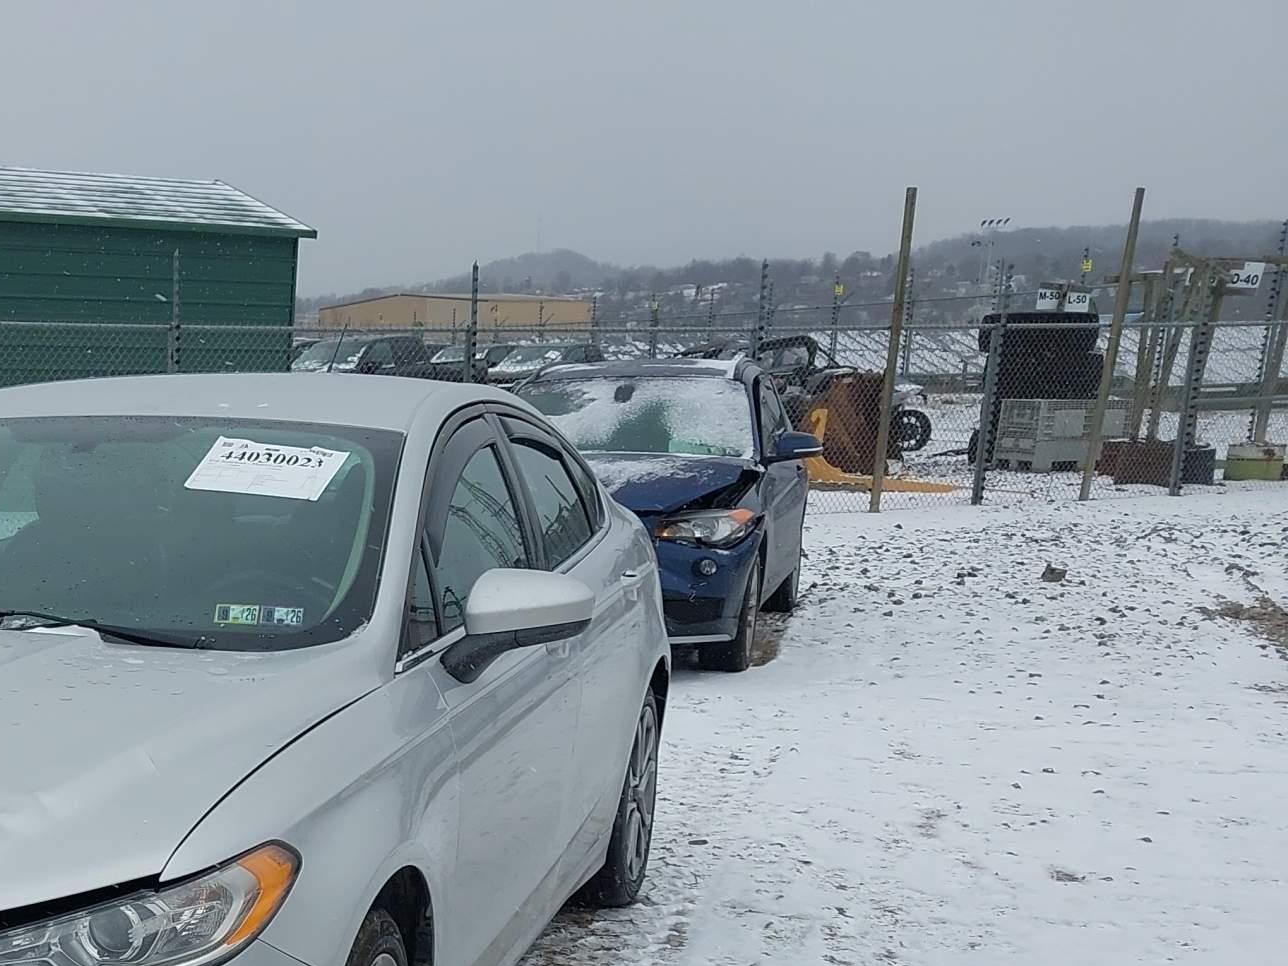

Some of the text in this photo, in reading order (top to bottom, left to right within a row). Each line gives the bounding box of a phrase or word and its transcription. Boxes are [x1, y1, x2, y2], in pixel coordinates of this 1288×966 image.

[1039, 292, 1061, 301] M-50
[1067, 295, 1087, 304] L-50
[220, 450, 324, 468] 44030023
[245, 607, 257, 621] 26
[290, 609, 302, 623] 26
